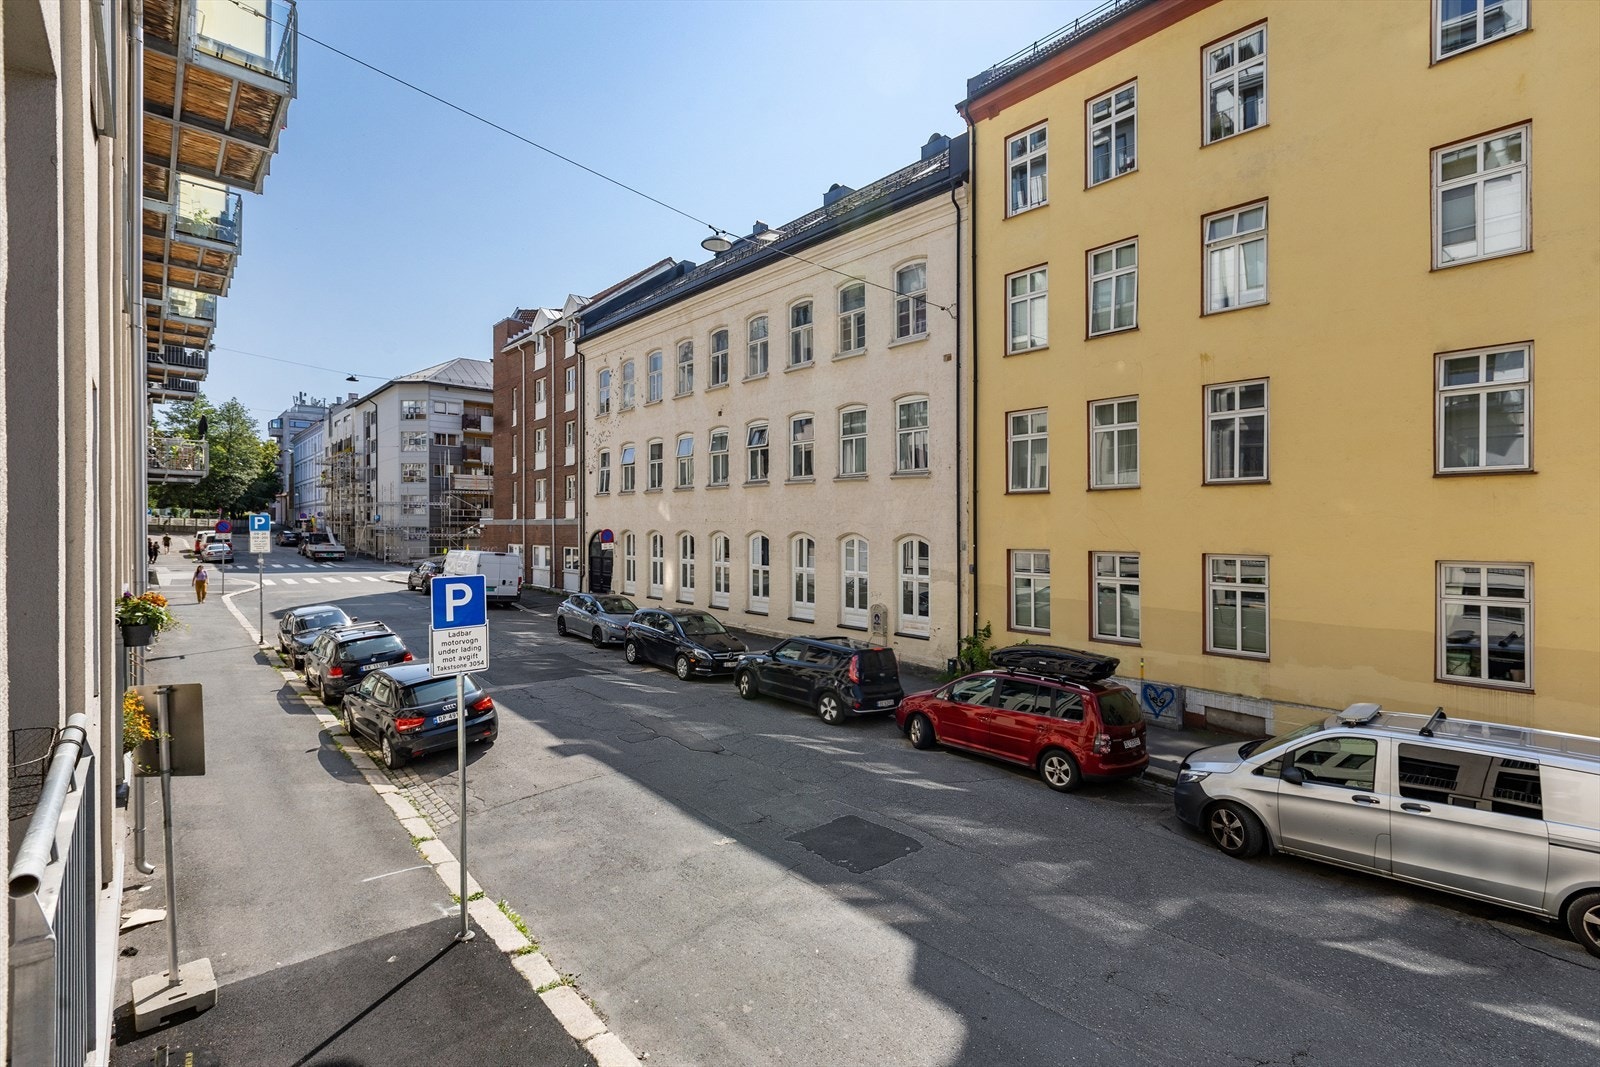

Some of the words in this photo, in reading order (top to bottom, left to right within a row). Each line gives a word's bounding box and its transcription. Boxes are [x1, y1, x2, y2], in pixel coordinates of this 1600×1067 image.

[254, 516, 266, 530] P
[446, 583, 473, 622] P
[441, 638, 478, 647] motorvogn
[461, 645, 482, 653] lading
[458, 653, 478, 662] avgift
